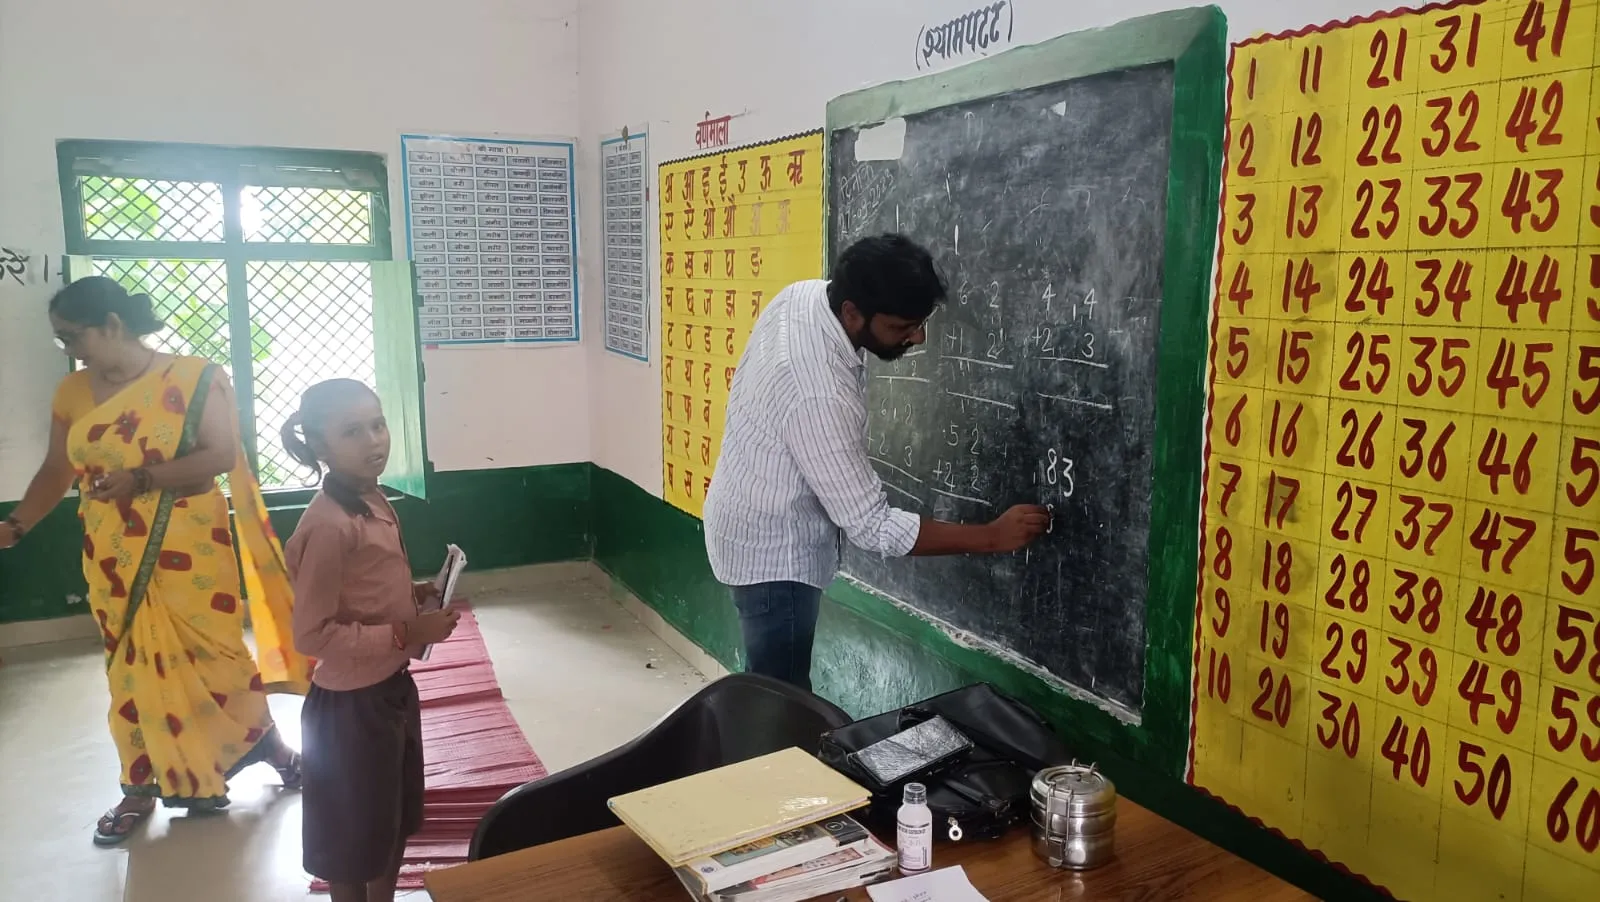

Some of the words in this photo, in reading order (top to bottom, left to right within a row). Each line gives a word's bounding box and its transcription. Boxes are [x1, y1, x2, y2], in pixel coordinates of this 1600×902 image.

[1247, 58, 1257, 99] 1
[1299, 46, 1323, 93] 11
[1366, 27, 1408, 89] 21
[1430, 12, 1482, 74] 31
[1513, 0, 1572, 62] 41
[696, 111, 732, 150] वर्णमाला
[1236, 122, 1257, 178] 2
[1290, 112, 1323, 167] 12
[1355, 103, 1403, 167] 22
[1421, 89, 1481, 158] 32
[1504, 79, 1564, 154] 42
[665, 173, 674, 204] अ
[682, 169, 695, 201] आ
[702, 166, 711, 204] इ
[718, 155, 728, 202] ई
[738, 160, 748, 193] उ
[760, 155, 772, 191] ऊ
[787, 150, 805, 188] ऋ
[665, 212, 674, 240] ए
[684, 201, 695, 239] ऐ
[703, 198, 715, 239] ओ
[723, 193, 736, 238] औ
[1232, 193, 1256, 246] 3
[1285, 184, 1324, 239] 13
[1350, 178, 1402, 241] 23
[1418, 172, 1483, 239] 33
[1500, 167, 1564, 234] 43
[665, 252, 674, 278] क
[685, 251, 695, 279] ख
[704, 250, 713, 278] ग
[665, 287, 674, 312] च
[685, 288, 695, 316] छ
[704, 289, 713, 318] ज
[1042, 283, 1056, 320] 4
[1084, 287, 1098, 320] 4
[1227, 261, 1254, 316] 4
[1281, 258, 1322, 314] 14
[1344, 255, 1395, 316] 24
[1415, 258, 1473, 322] 34
[1495, 255, 1563, 325] 44
[667, 322, 674, 347] ट
[685, 324, 693, 350] ठ
[704, 326, 712, 353] ड
[725, 328, 735, 355] ढ
[1082, 332, 1095, 358] 3
[665, 355, 674, 384] त
[703, 363, 712, 394] द
[1226, 326, 1249, 380] 5
[1276, 329, 1313, 385] 15
[1338, 331, 1391, 395] 25
[1407, 336, 1471, 398] 35
[1486, 340, 1554, 409] 45
[666, 391, 673, 419] प
[683, 395, 692, 424] फ
[683, 429, 691, 460] र
[701, 435, 712, 466] ल
[904, 445, 913, 467] 3
[1224, 395, 1249, 448] 6
[1268, 400, 1304, 458] 16
[1335, 408, 1384, 470] 26
[1399, 419, 1456, 482] 36
[1477, 430, 1539, 496] 46
[684, 469, 693, 498] स
[1047, 448, 1074, 497] 83
[1218, 462, 1243, 517] 7
[1263, 470, 1301, 529] 17
[1330, 480, 1378, 544] 27
[1394, 494, 1454, 557] 37
[1469, 509, 1537, 575] 47
[1212, 525, 1233, 582] 8
[1261, 542, 1293, 596] 18
[1324, 555, 1371, 614] 28
[1389, 568, 1444, 635] 38
[1465, 587, 1524, 657] 48
[1211, 587, 1231, 639] 9
[1259, 601, 1290, 660] 19
[1320, 622, 1368, 685] 29
[1384, 637, 1439, 707] 39
[1457, 660, 1523, 736] 49
[1207, 648, 1233, 704] 10
[1251, 667, 1292, 728] 20
[1317, 692, 1361, 759] 30
[1380, 719, 1432, 788] 40
[1453, 741, 1511, 820] 50
[1547, 779, 1600, 853] 60
